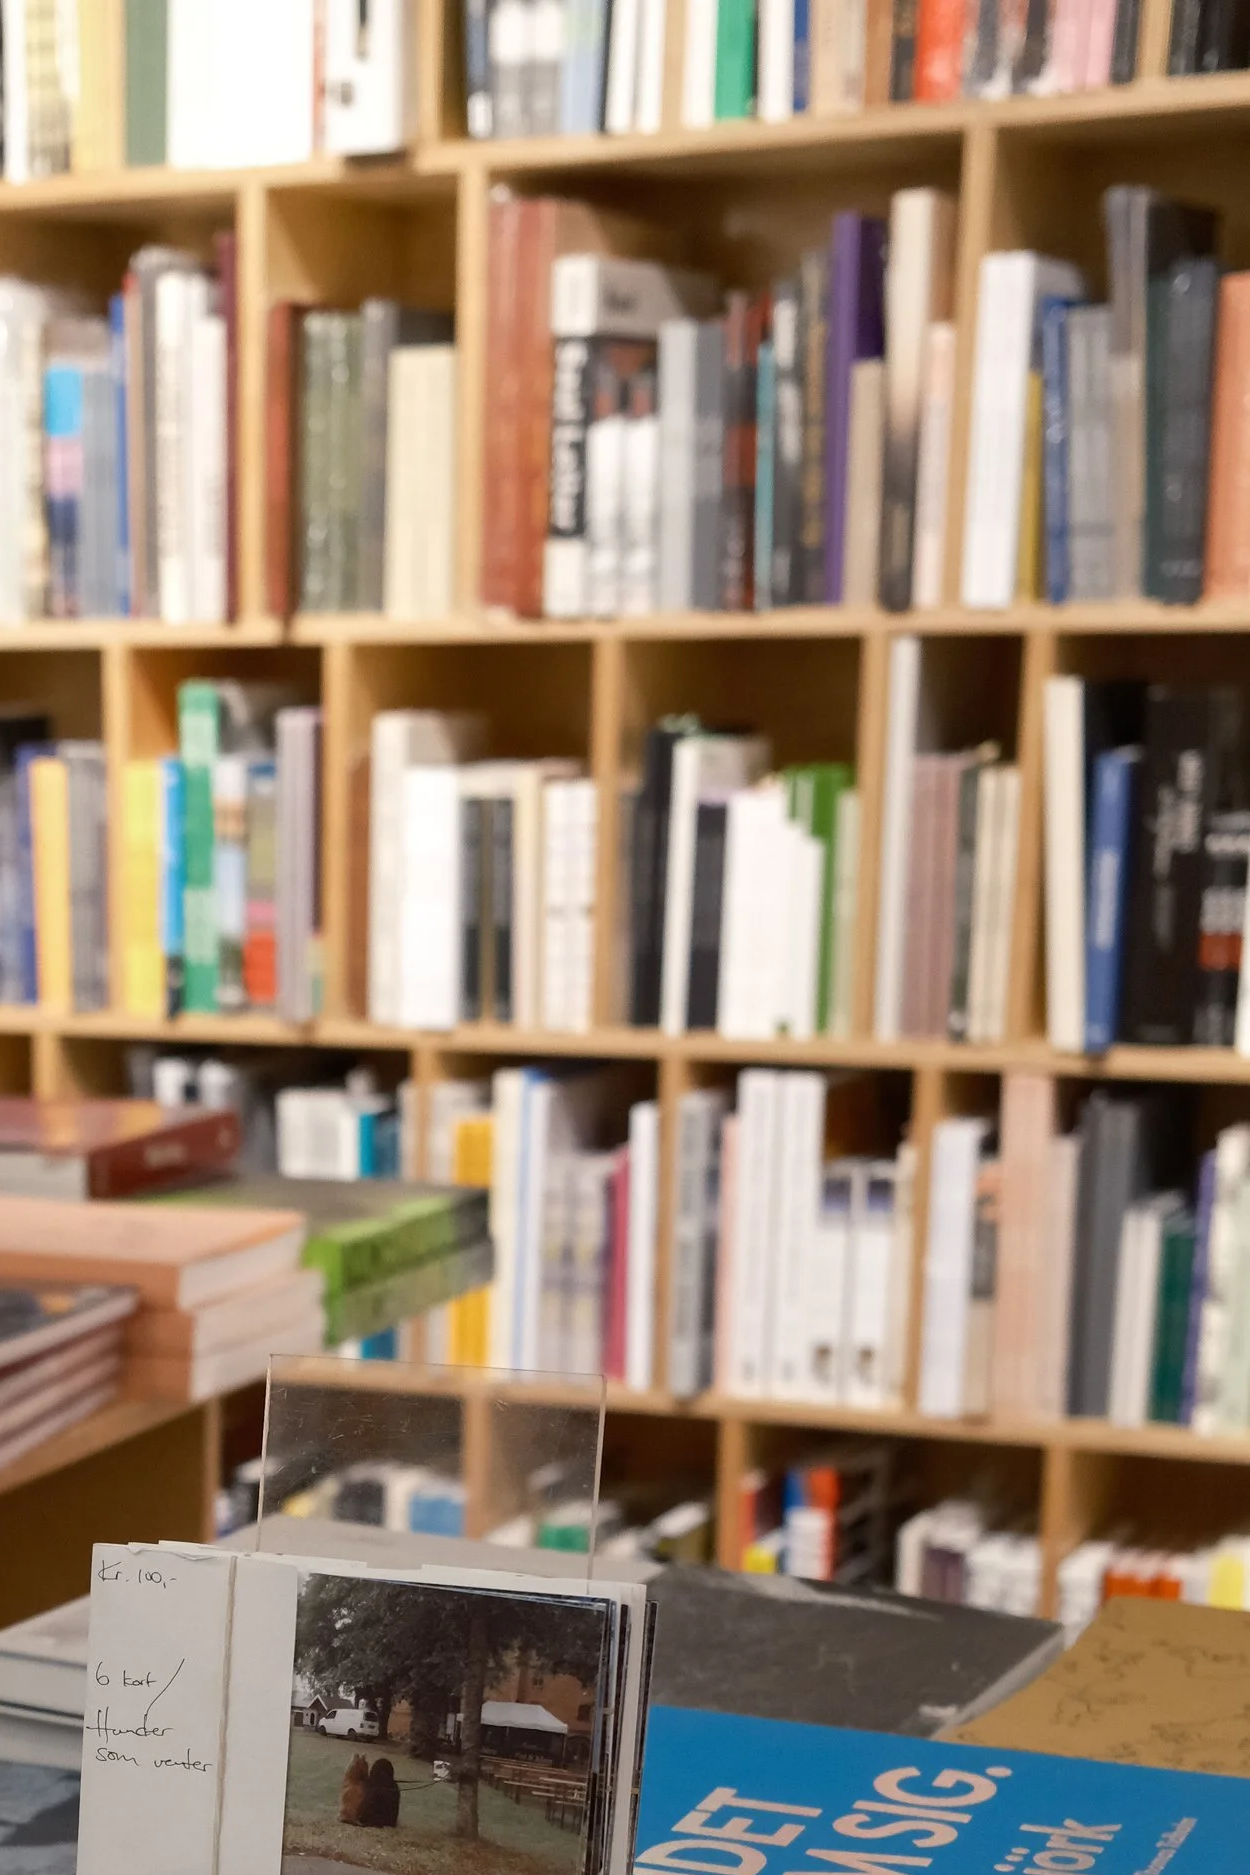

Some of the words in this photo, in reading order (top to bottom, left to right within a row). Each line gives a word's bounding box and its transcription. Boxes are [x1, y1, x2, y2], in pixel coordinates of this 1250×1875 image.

[97, 1559, 129, 1582] Kr.
[95, 1661, 110, 1686] 6
[95, 1747, 140, 1767] som
[154, 1748, 213, 1772] venter
[832, 1765, 1014, 1849] SIG.
